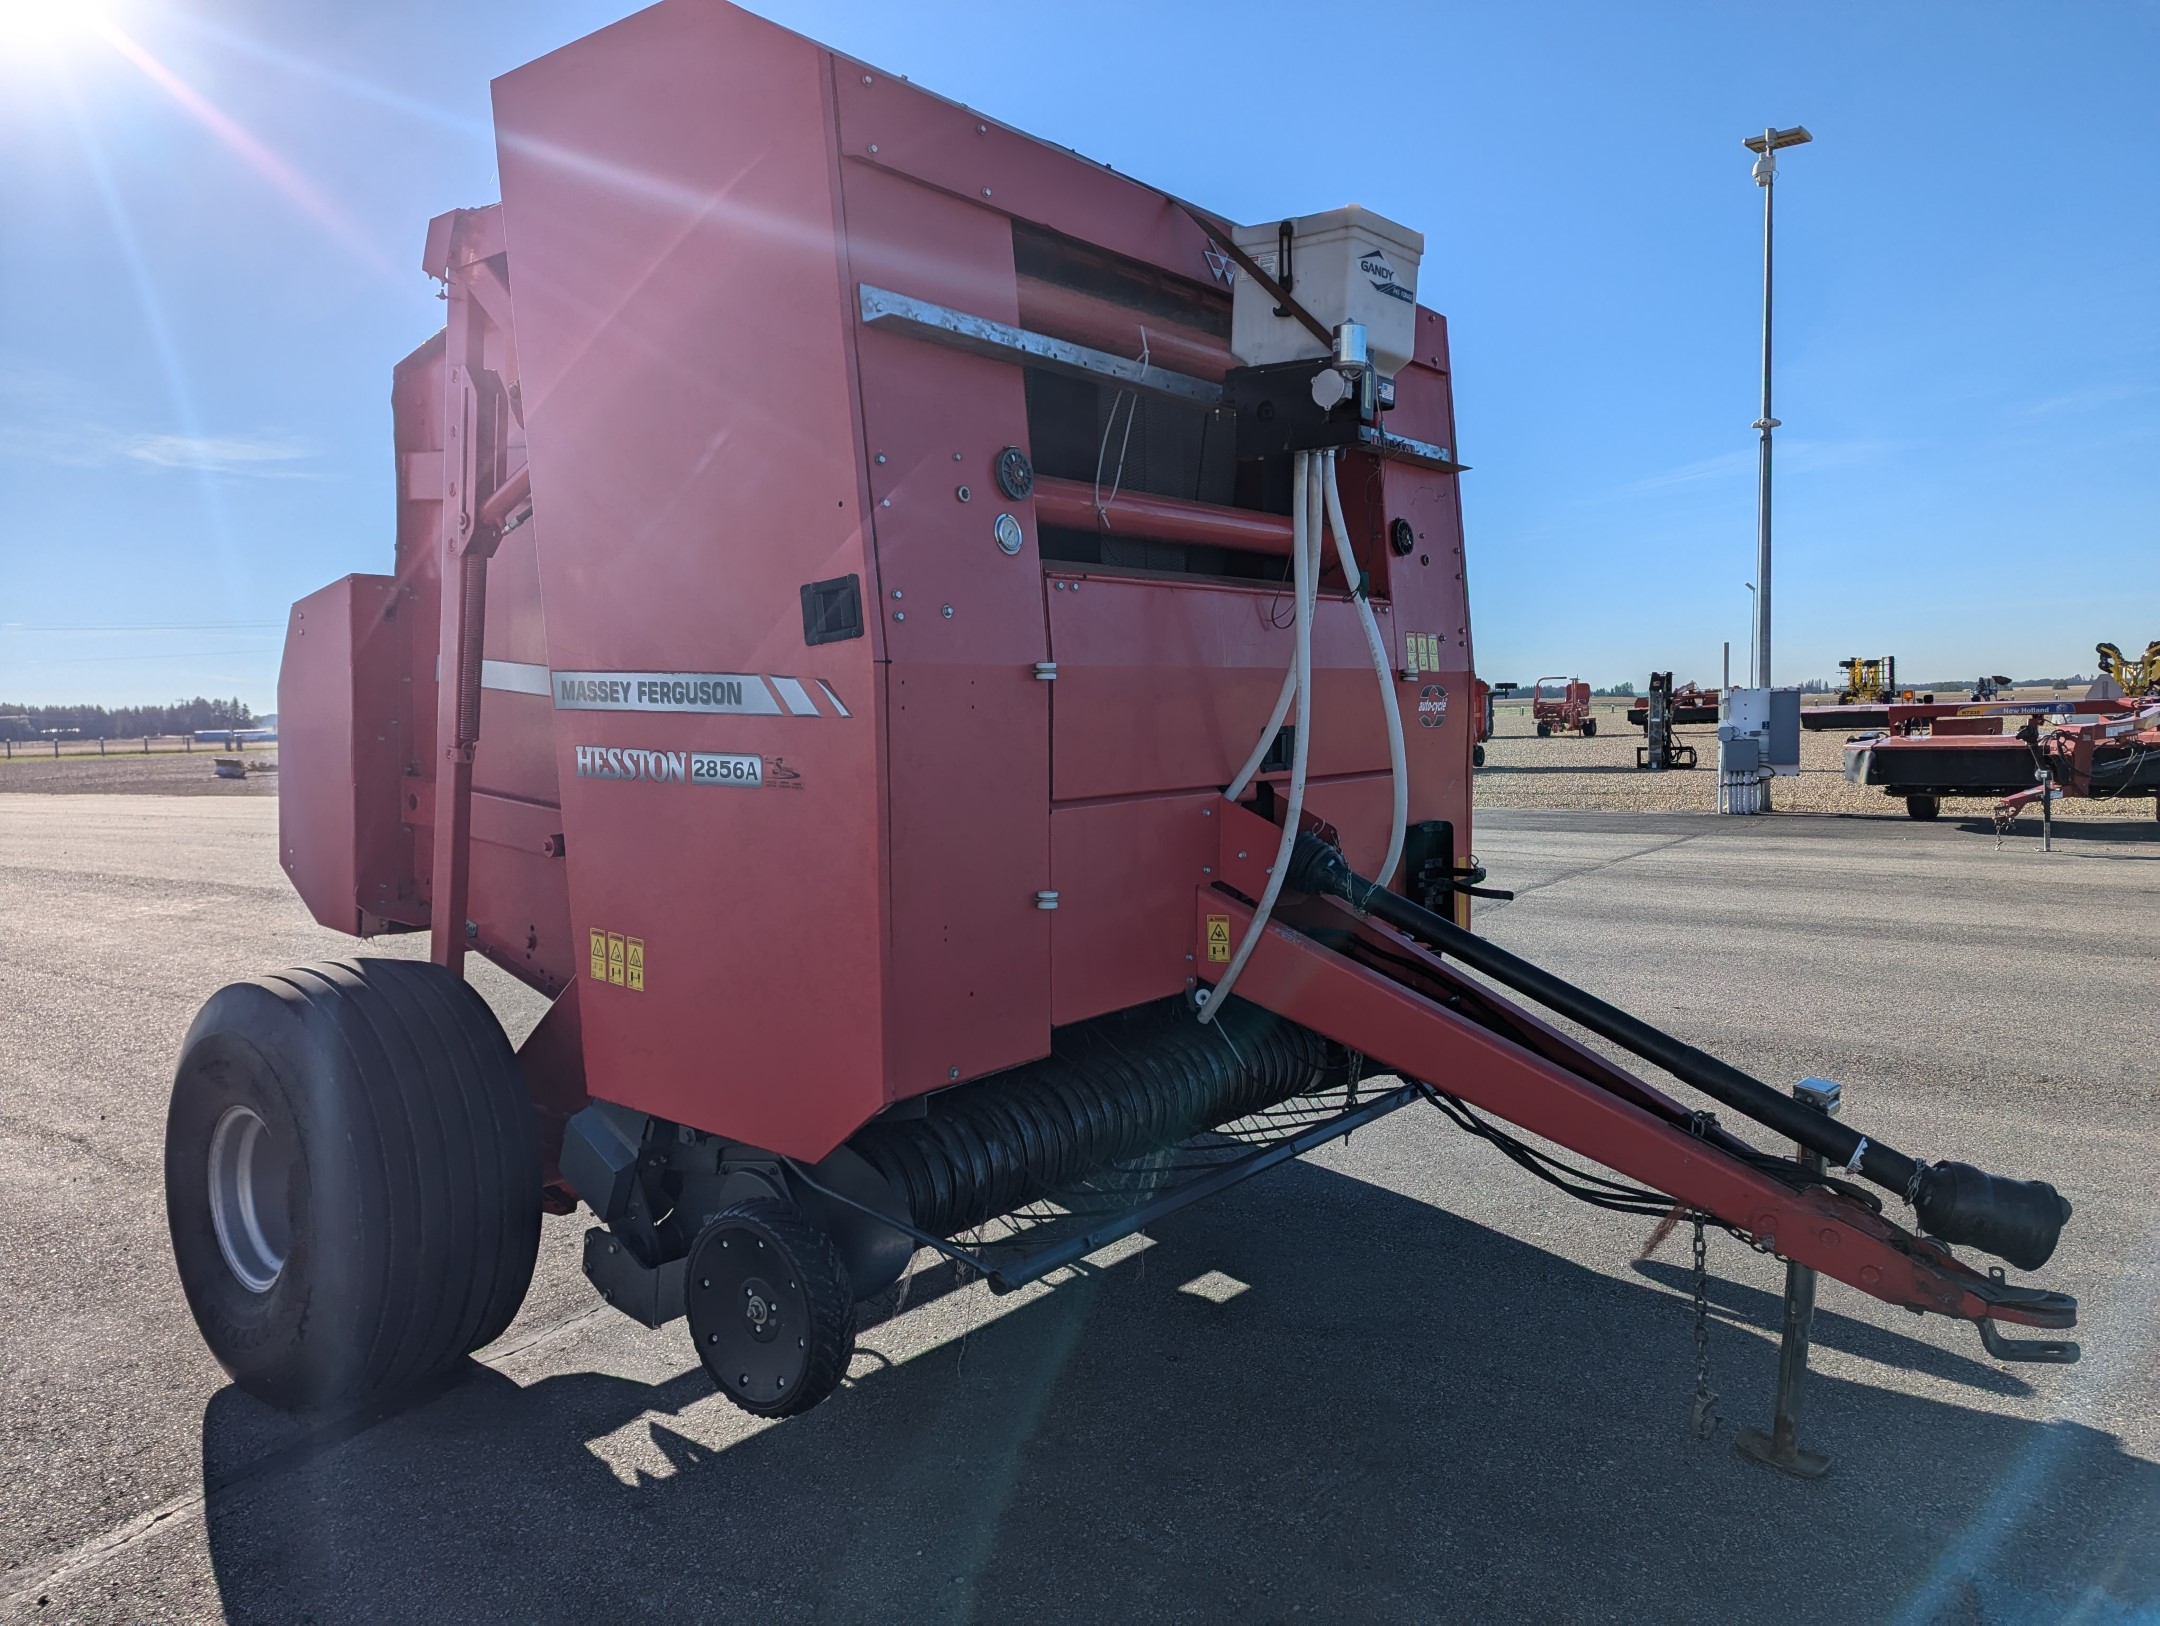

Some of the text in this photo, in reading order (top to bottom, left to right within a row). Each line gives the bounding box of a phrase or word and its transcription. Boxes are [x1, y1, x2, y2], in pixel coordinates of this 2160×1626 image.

[1360, 260, 1395, 281] GANDY
[561, 680, 743, 706] MASSEY FERGUSON
[2003, 706, 2050, 715] New Holland
[575, 745, 687, 785] HESSTON
[693, 759, 759, 781] 2856A
